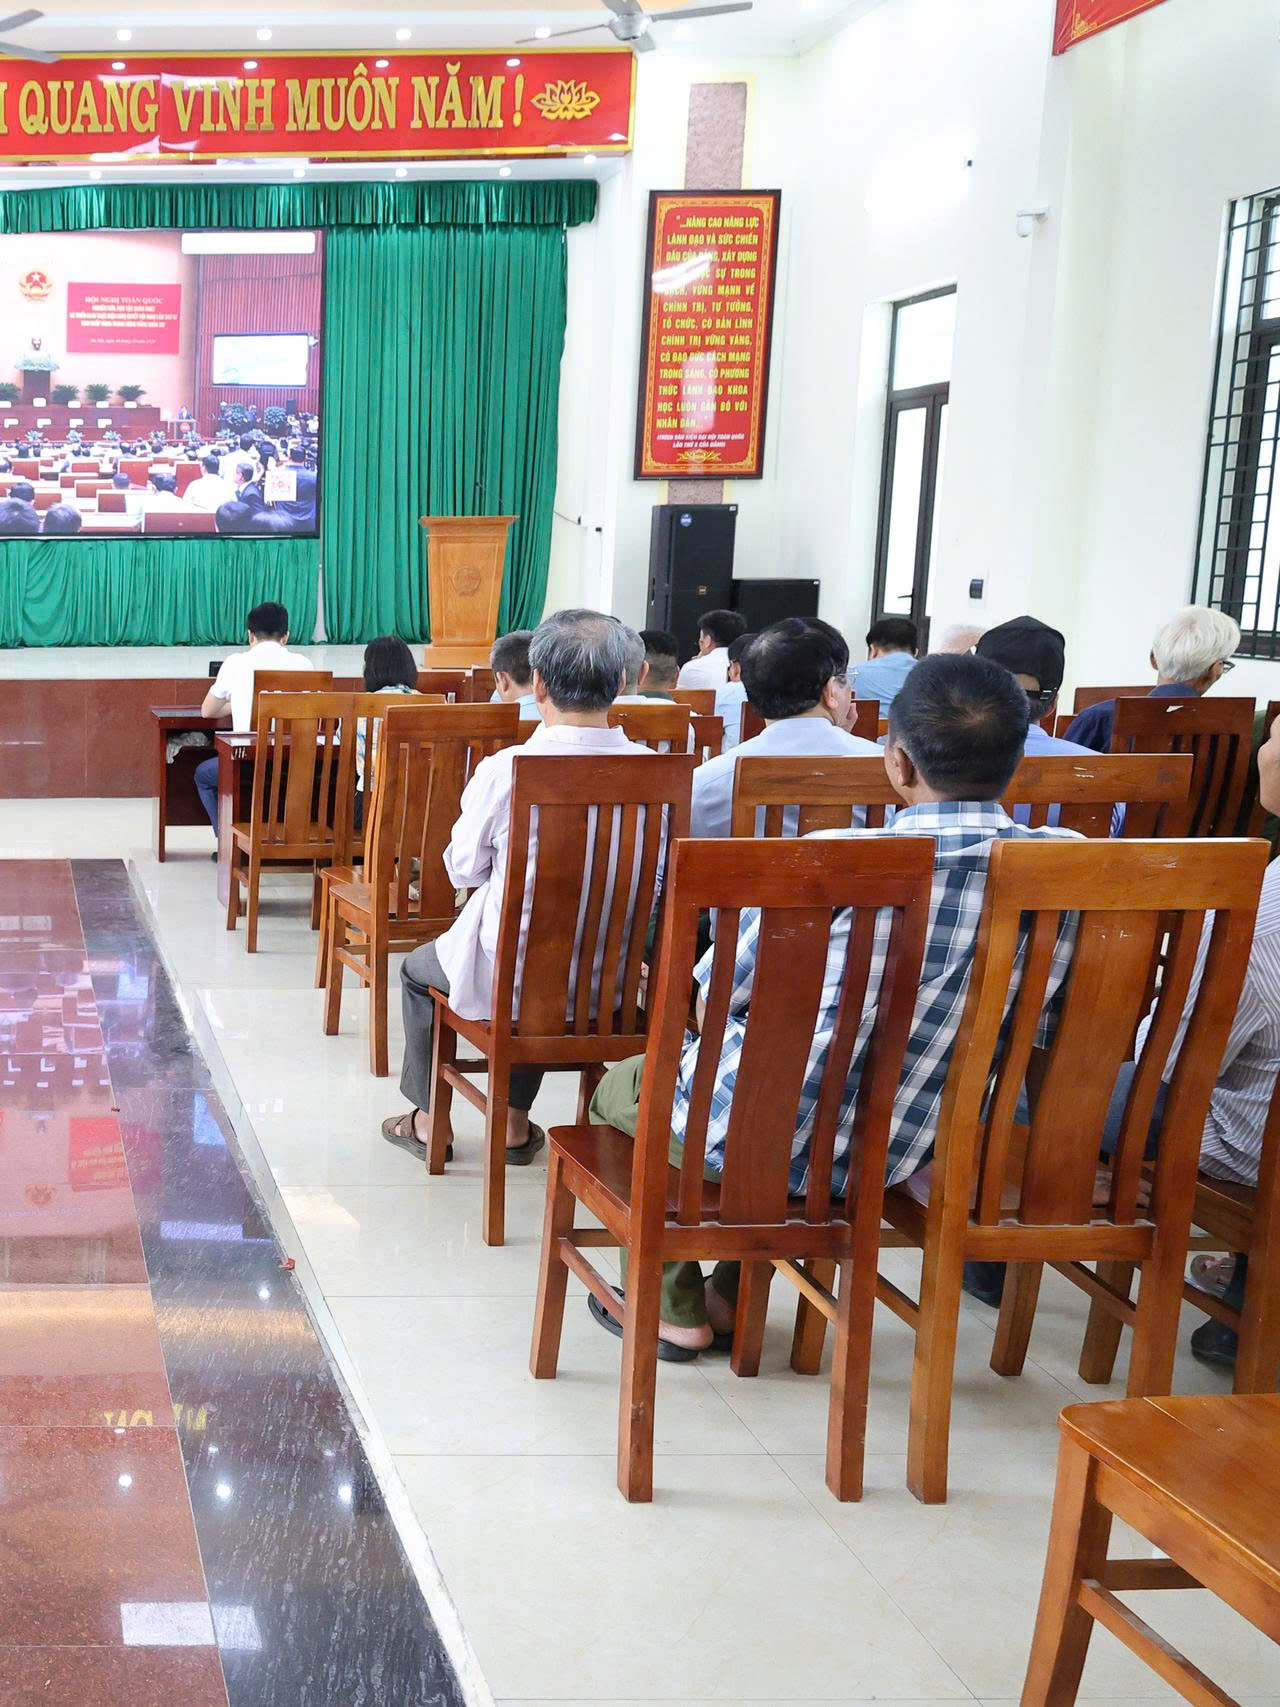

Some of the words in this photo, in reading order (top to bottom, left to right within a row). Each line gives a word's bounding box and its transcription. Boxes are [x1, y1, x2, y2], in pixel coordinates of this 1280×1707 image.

[18, 80, 158, 136] QUANG
[170, 78, 275, 133] VINH
[285, 62, 399, 130] MUÔN
[708, 216, 722, 228] CAO
[746, 216, 760, 228] LỰC
[706, 233, 716, 245] VÀ
[731, 268, 756, 279] TRONG
[702, 317, 712, 328] CÓ
[661, 334, 685, 345] CHÍNH
[661, 351, 671, 362] CÓ
[660, 368, 683, 378] TRONG
[727, 384, 748, 395] KHOA
